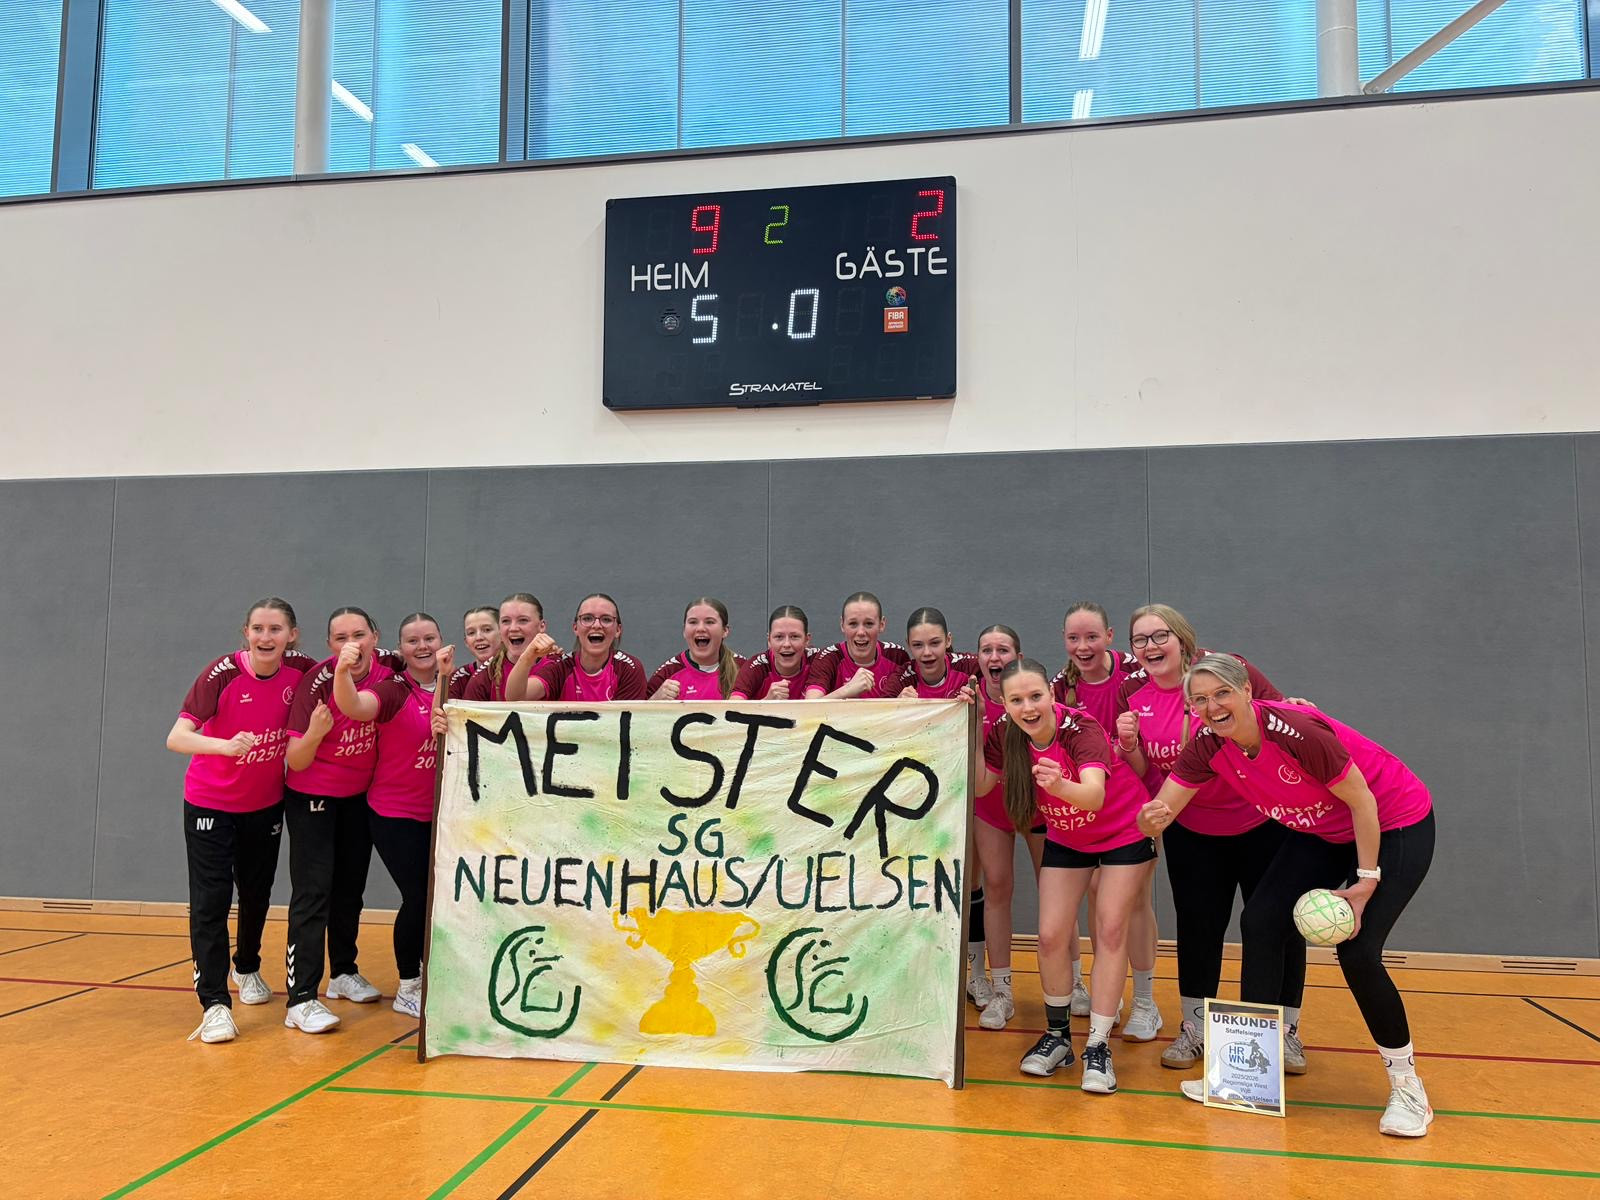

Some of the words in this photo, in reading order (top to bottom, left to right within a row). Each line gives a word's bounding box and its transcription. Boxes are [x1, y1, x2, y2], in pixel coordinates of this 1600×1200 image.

[764, 204, 789, 244] 2
[911, 189, 944, 241] 2
[691, 204, 721, 255] 9
[836, 246, 948, 280] GÄSTE
[630, 261, 709, 291] HEIM
[691, 294, 718, 344] 5
[887, 311, 904, 320] FIBA
[729, 381, 822, 396] STRAMATEL
[254, 728, 287, 746] eiste
[334, 735, 376, 757] 2025/
[1147, 740, 1185, 758] Meis
[465, 710, 940, 858] MEISTER
[1040, 803, 1080, 816] eiste
[196, 818, 214, 830] NV
[1049, 811, 1096, 831] 25/26
[659, 813, 724, 858] SG
[454, 851, 962, 919] NEUENHAUS/UELSEN
[1212, 1013, 1278, 1030] URKUNDE
[1229, 1046, 1245, 1055] HR
[1229, 1055, 1245, 1064] WN
